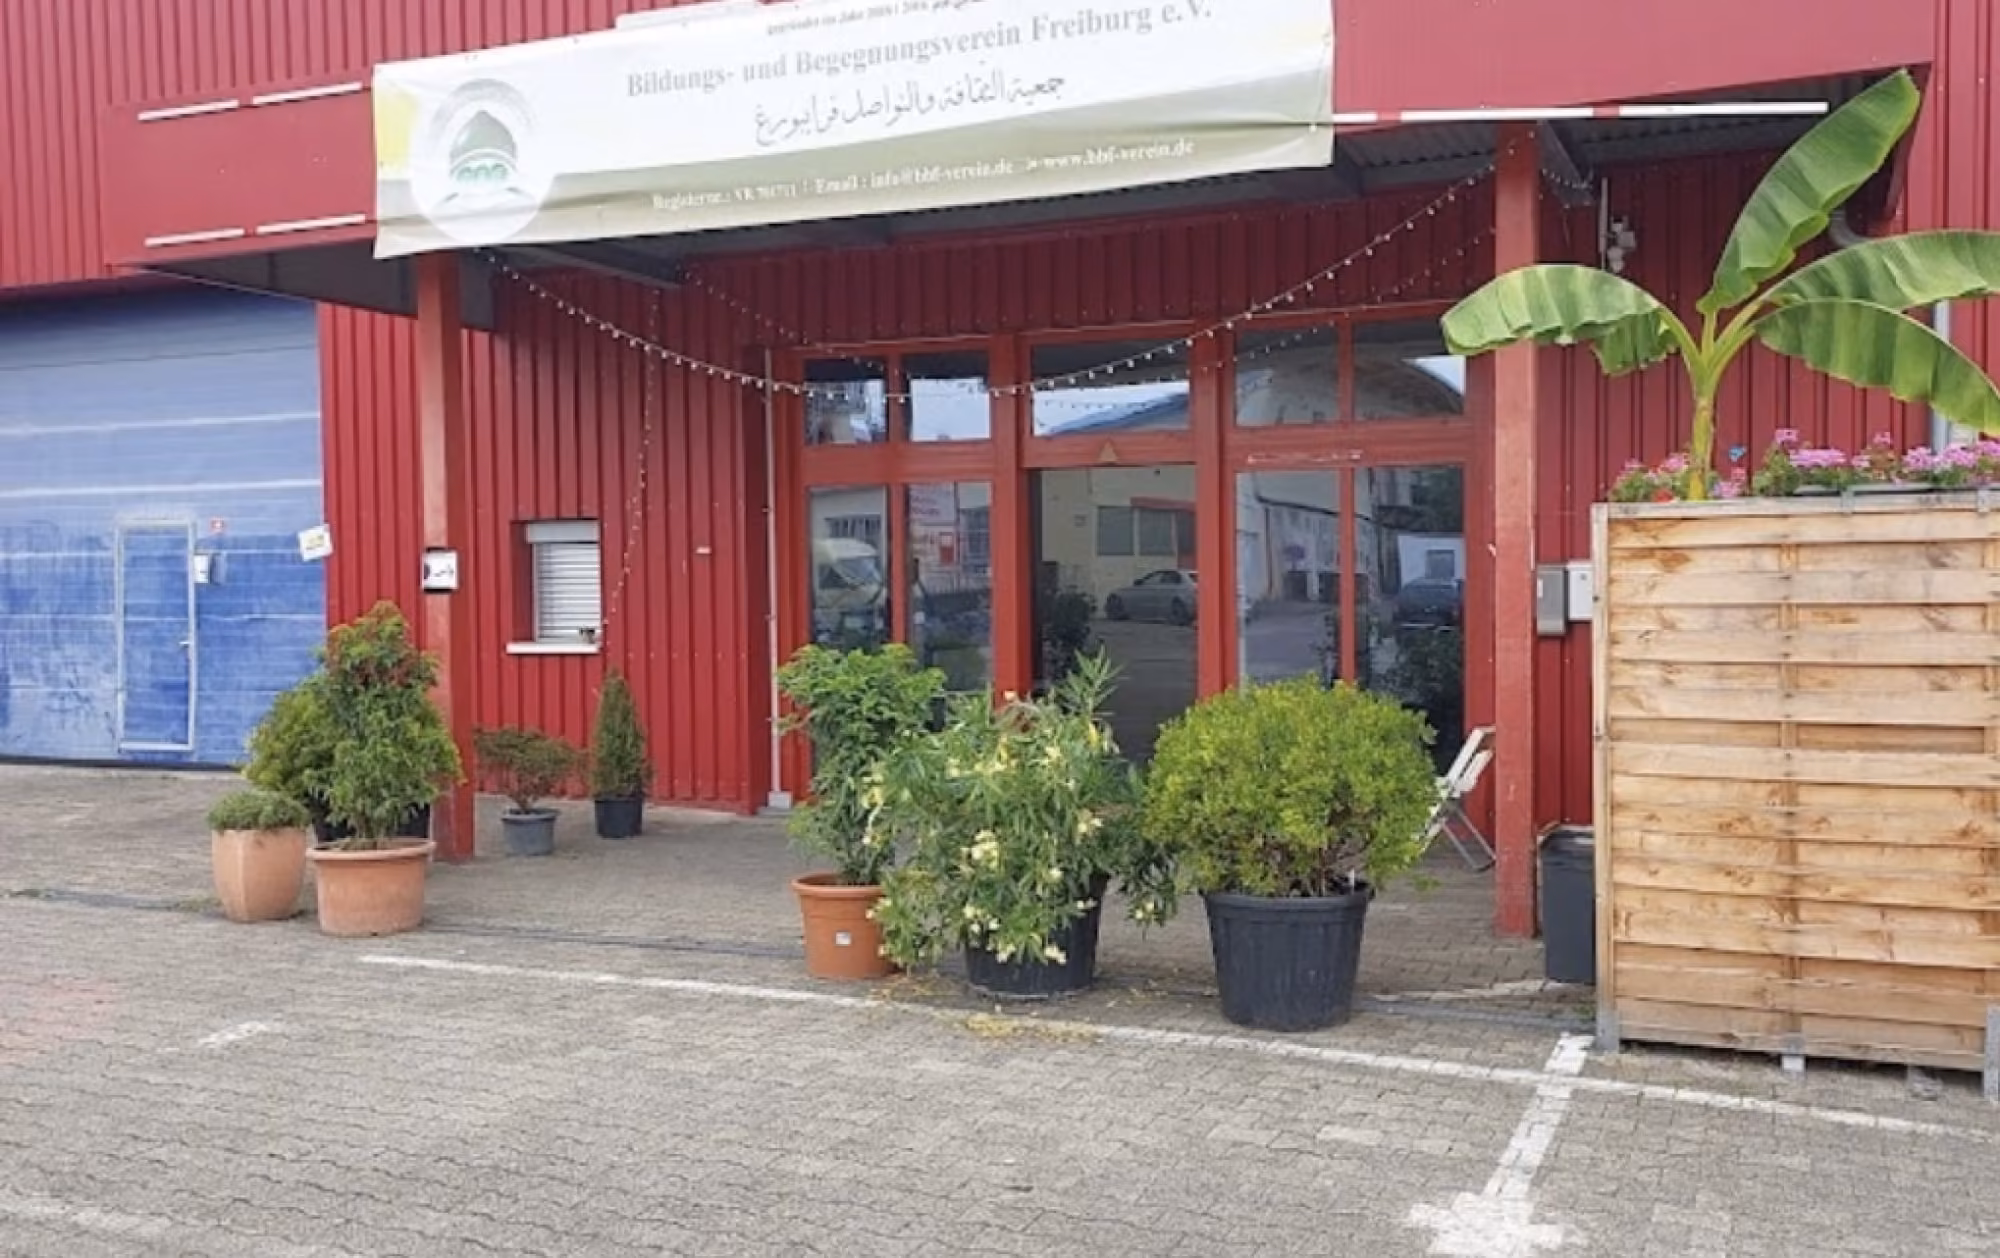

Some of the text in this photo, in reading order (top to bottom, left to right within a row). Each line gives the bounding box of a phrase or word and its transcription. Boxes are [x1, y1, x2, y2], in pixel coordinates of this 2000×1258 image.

[627, 69, 735, 98] Bildungs-
[743, 54, 787, 83] und
[796, 24, 1020, 77] Begegnungsverein
[1031, 8, 1153, 43] Freiburg
